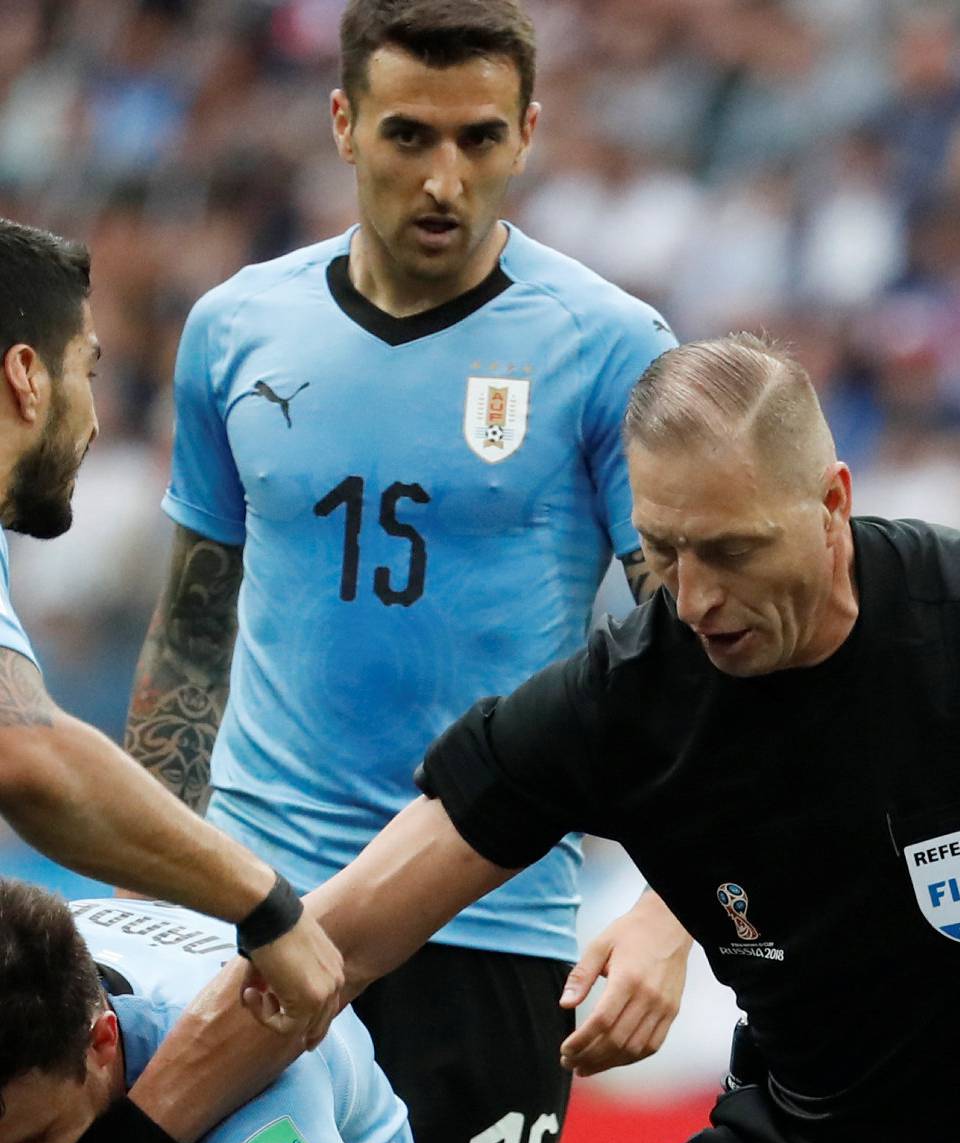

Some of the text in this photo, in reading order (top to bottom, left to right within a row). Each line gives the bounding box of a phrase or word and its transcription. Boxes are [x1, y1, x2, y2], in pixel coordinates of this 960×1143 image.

[313, 476, 431, 607] 15
[719, 946, 785, 961] RUSSIA 2018
